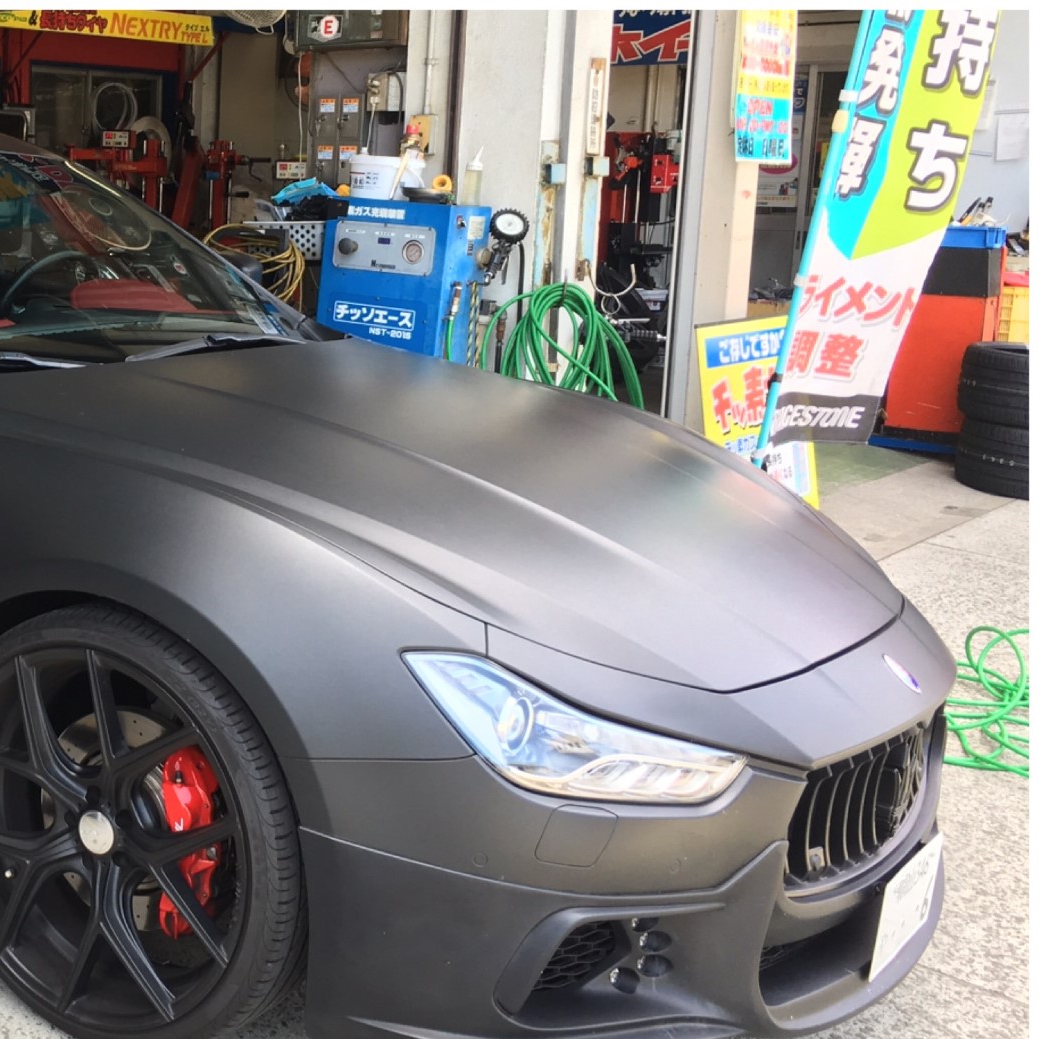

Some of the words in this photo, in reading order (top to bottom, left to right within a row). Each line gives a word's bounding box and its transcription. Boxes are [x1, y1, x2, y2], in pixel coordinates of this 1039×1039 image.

[28, 10, 38, 26] &
[109, 12, 183, 40] NEXTRY
[323, 19, 333, 35] E
[181, 31, 201, 43] TYPE
[202, 33, 209, 44] L
[336, 304, 413, 328] チッソエース
[711, 364, 775, 434] チッ素
